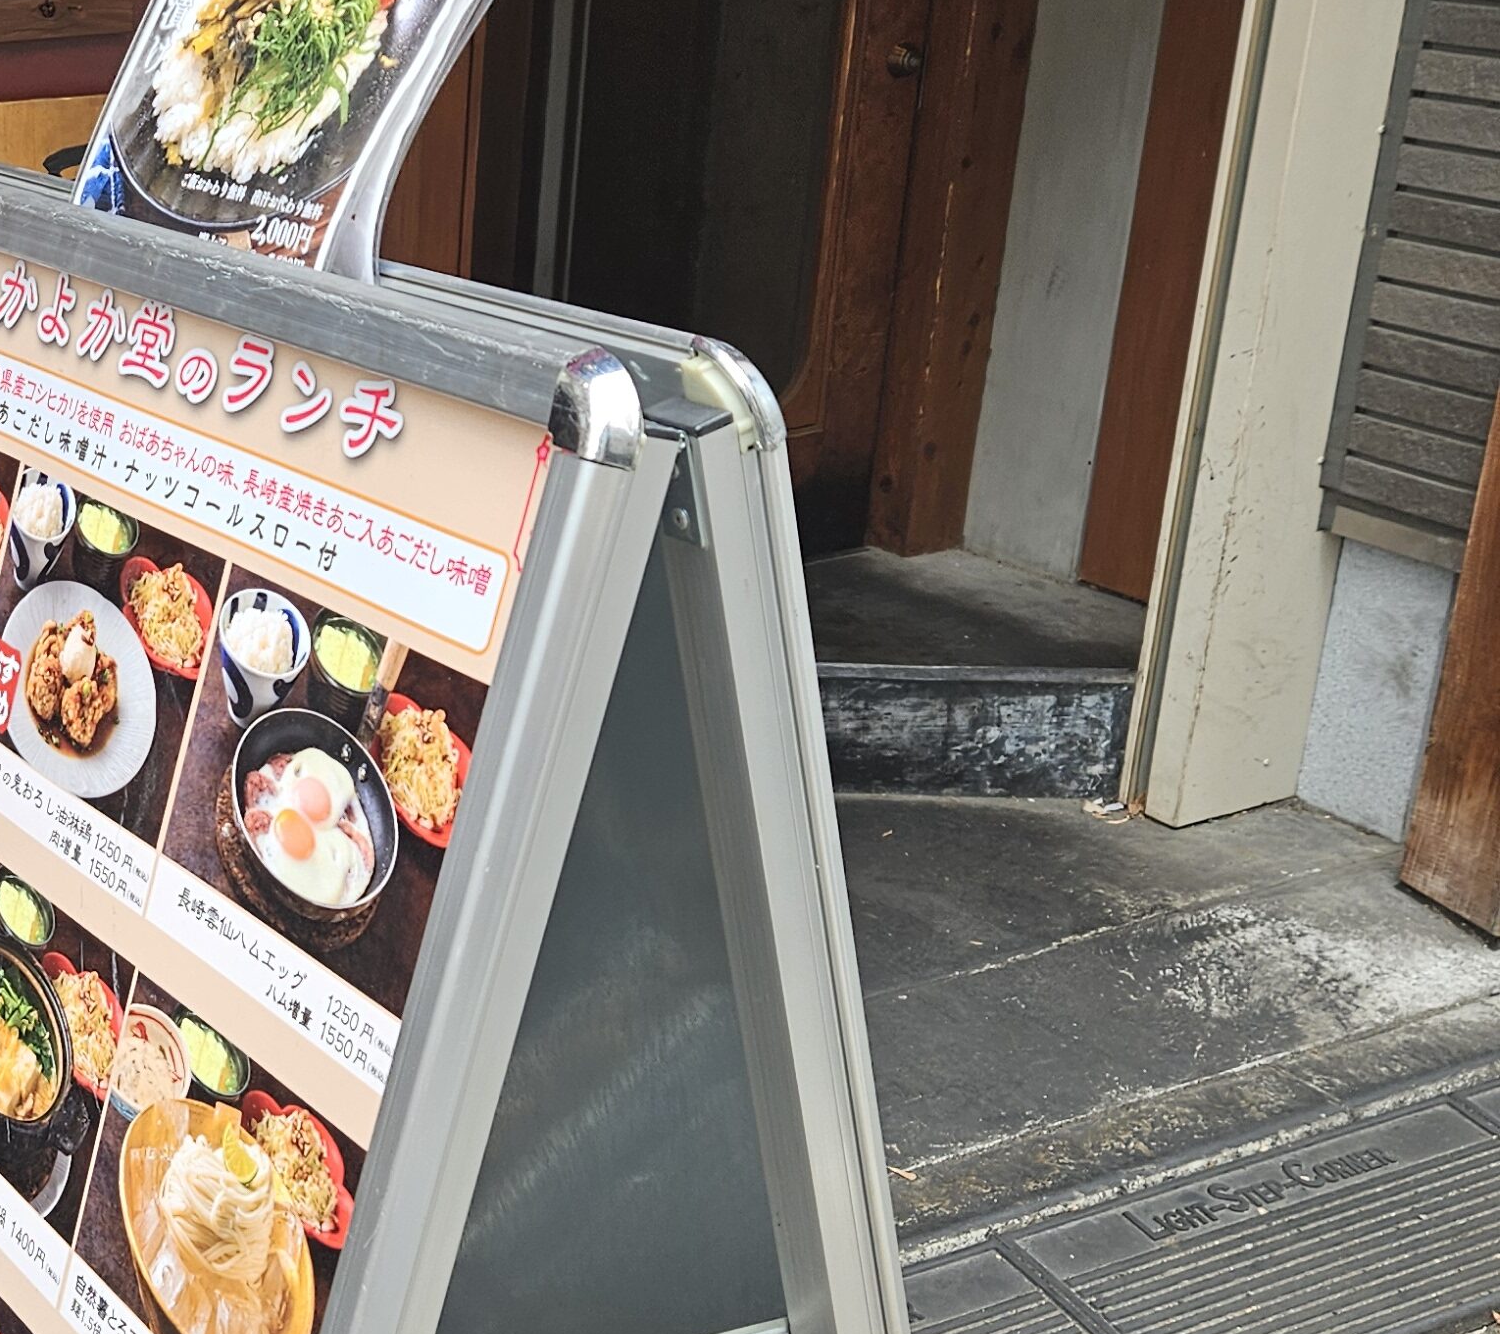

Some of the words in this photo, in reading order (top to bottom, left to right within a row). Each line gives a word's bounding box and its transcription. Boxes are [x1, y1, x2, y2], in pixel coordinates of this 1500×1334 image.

[251, 214, 316, 255] 2,000円
[94, 832, 133, 874] 1250円
[89, 857, 128, 897] 1550円
[177, 886, 308, 990] 長崎雲仙ハムエッグ
[326, 994, 375, 1044] 1250円
[320, 1021, 368, 1071] 1550円
[10, 1221, 46, 1270] 1400円
